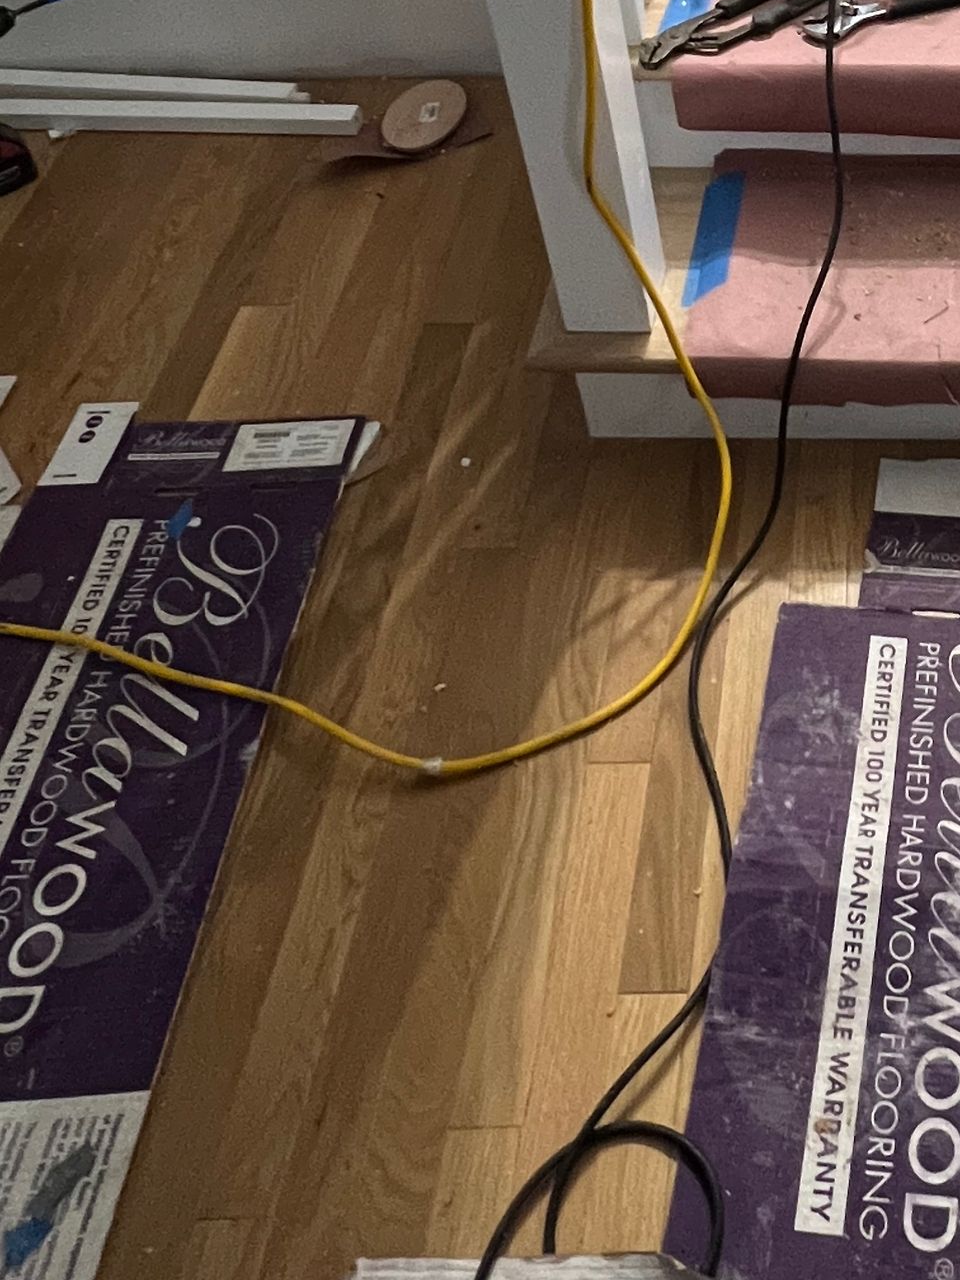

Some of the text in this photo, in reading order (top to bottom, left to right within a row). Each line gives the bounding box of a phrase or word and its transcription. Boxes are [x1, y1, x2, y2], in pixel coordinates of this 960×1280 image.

[82, 524, 131, 612] CERTIFIED
[38, 650, 75, 702] YEAR
[870, 642, 897, 744] CERTIFIED
[20, 670, 113, 848] HARDWOOD
[866, 749, 886, 784] 100
[855, 789, 881, 840] YEAR
[832, 844, 874, 1041] TRANSFERABLE
[858, 641, 942, 1241] PREFINISHED HARDWOOD FLOORING
